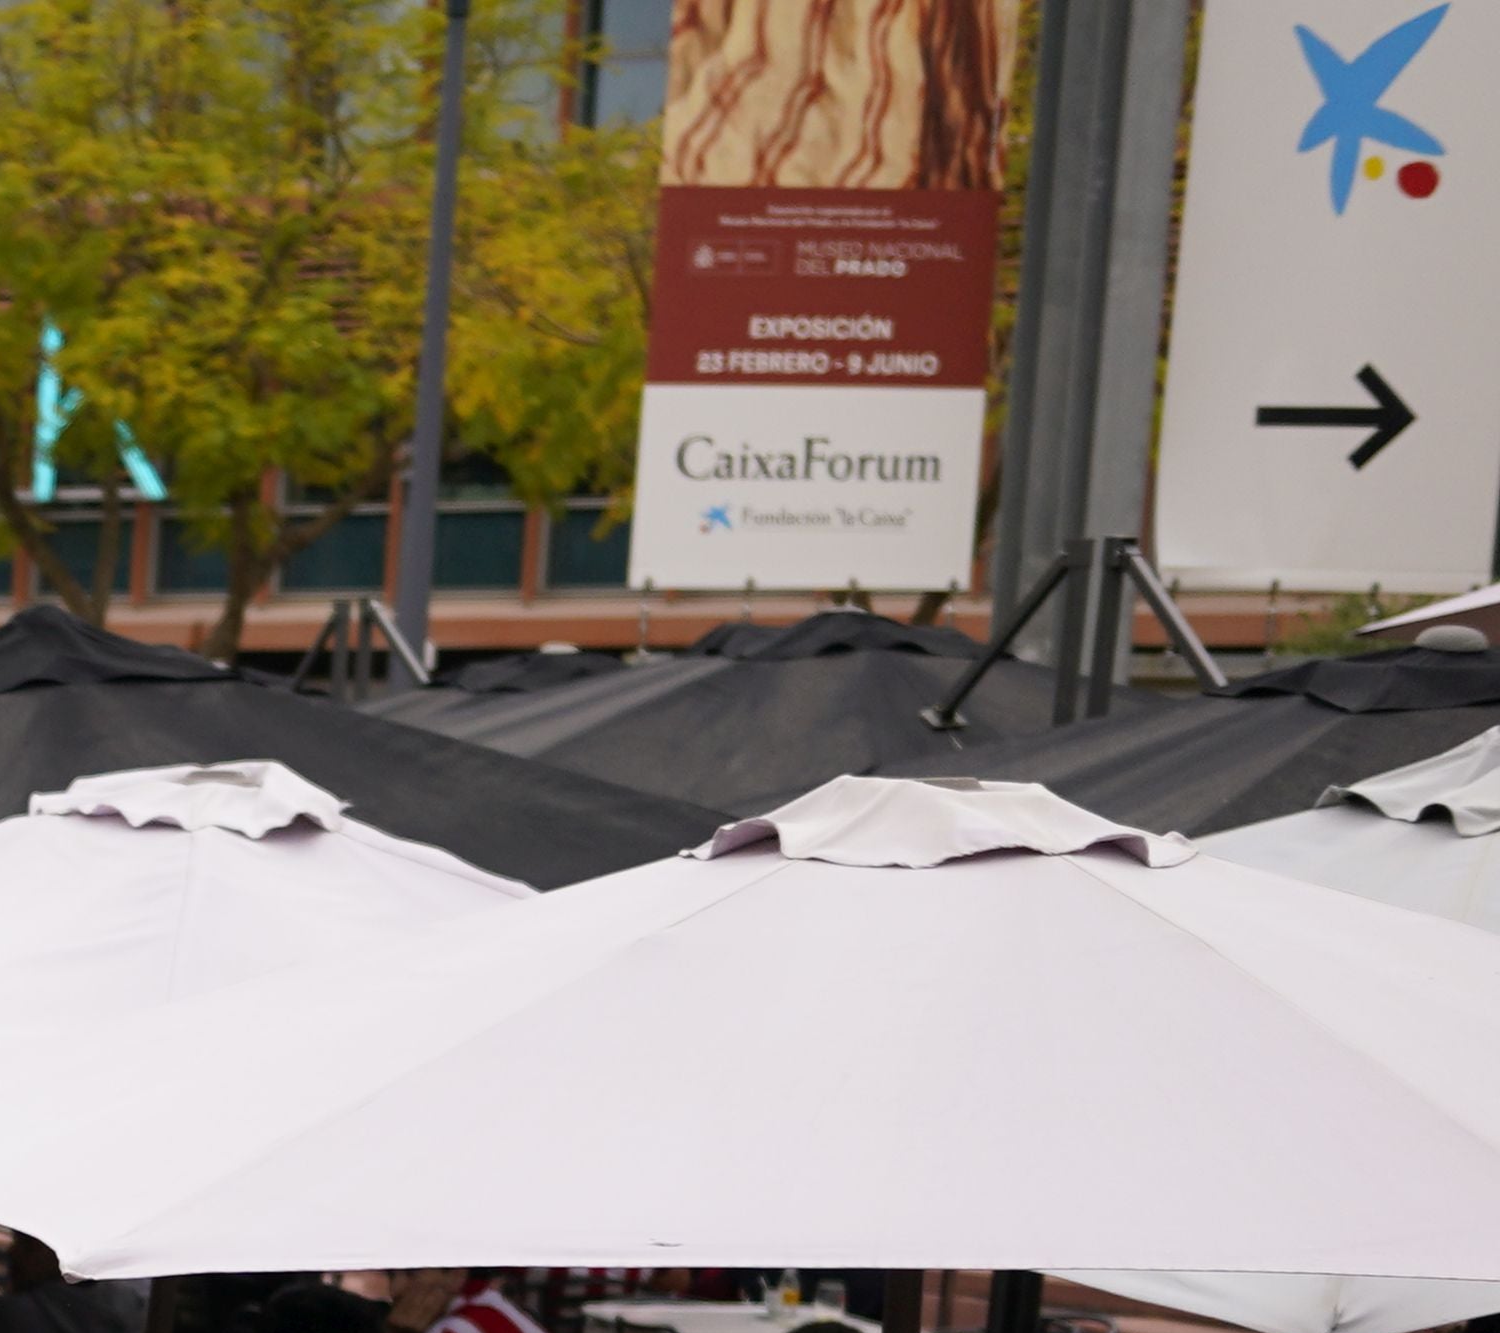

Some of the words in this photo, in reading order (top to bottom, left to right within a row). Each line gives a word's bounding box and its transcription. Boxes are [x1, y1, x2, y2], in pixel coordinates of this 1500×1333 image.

[868, 243, 963, 261] NACIONAL
[834, 259, 907, 277] PRADO
[750, 314, 894, 340] EXPOSICIÓN
[697, 351, 724, 373] 23
[729, 351, 830, 374] FEBRERO
[847, 353, 862, 375] 9
[866, 353, 940, 376] JUNIO
[674, 434, 942, 482] CaixaForum
[741, 508, 831, 527] Fundación
